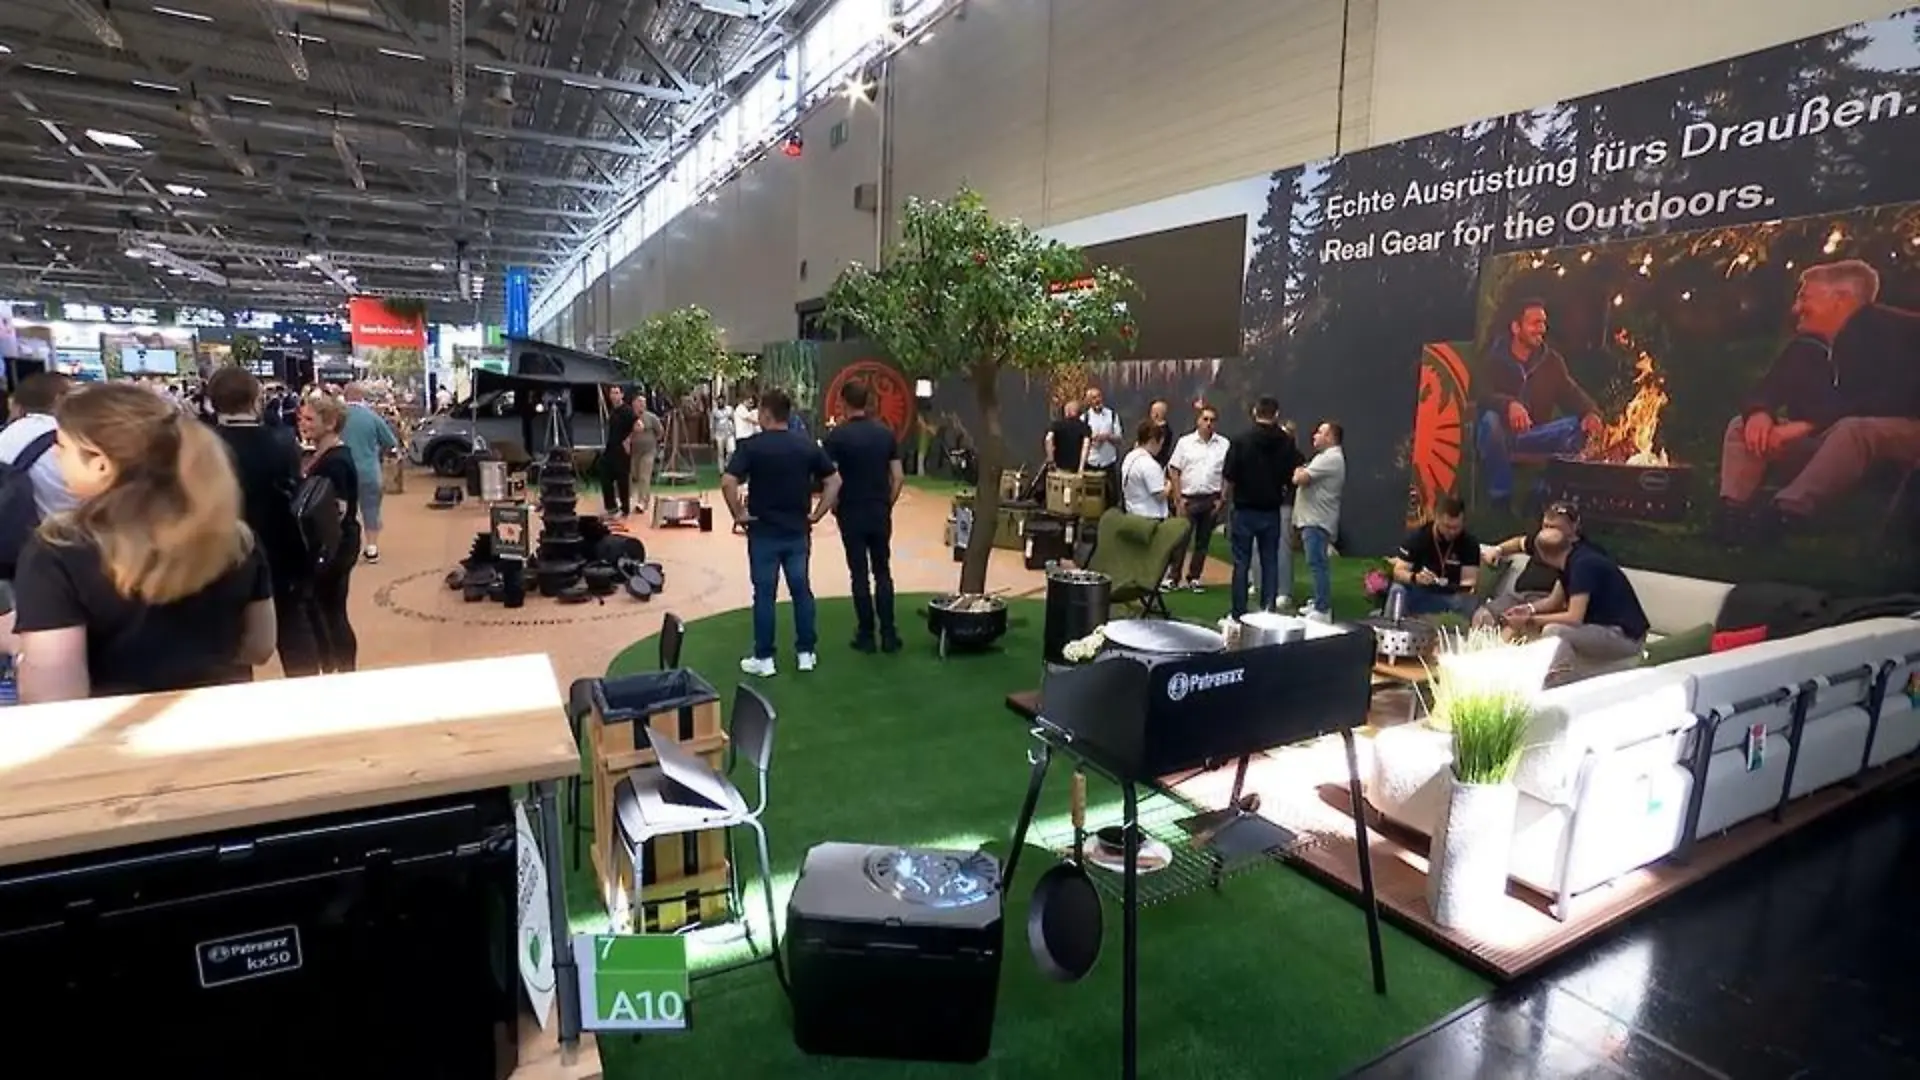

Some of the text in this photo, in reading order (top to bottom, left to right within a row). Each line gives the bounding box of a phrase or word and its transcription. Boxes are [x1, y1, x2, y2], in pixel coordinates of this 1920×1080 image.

[1327, 91, 1918, 221] Echte Ausrüstung fürs Draußen.
[1323, 183, 1775, 262] Real Gear for the Outdoors.
[247, 950, 291, 971] kx50
[598, 937, 616, 960] 7
[609, 990, 684, 1021] A10
